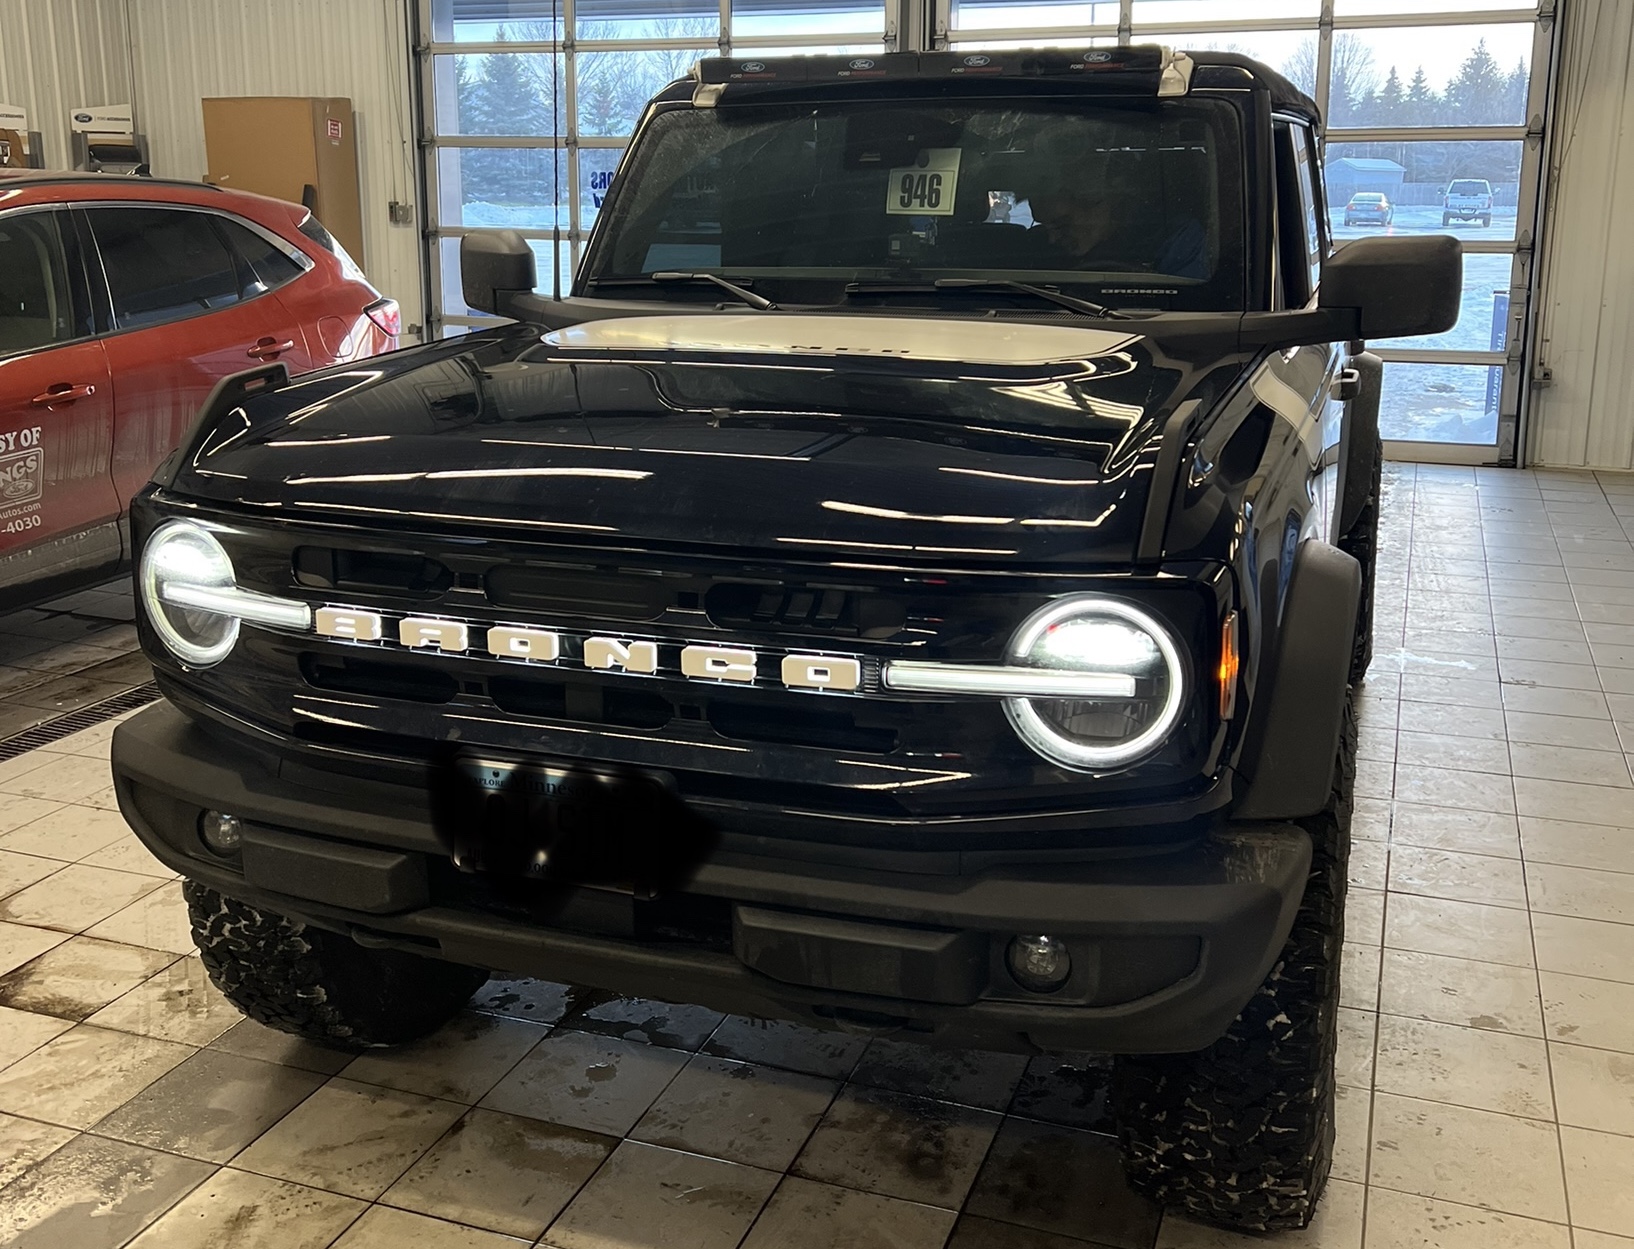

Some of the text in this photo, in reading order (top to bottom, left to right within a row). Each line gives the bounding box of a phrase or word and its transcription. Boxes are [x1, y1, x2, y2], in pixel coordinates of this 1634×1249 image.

[900, 173, 943, 209] 946
[20, 427, 41, 447] OF
[1, 515, 41, 533] -4030
[316, 607, 860, 690] BRONCO
